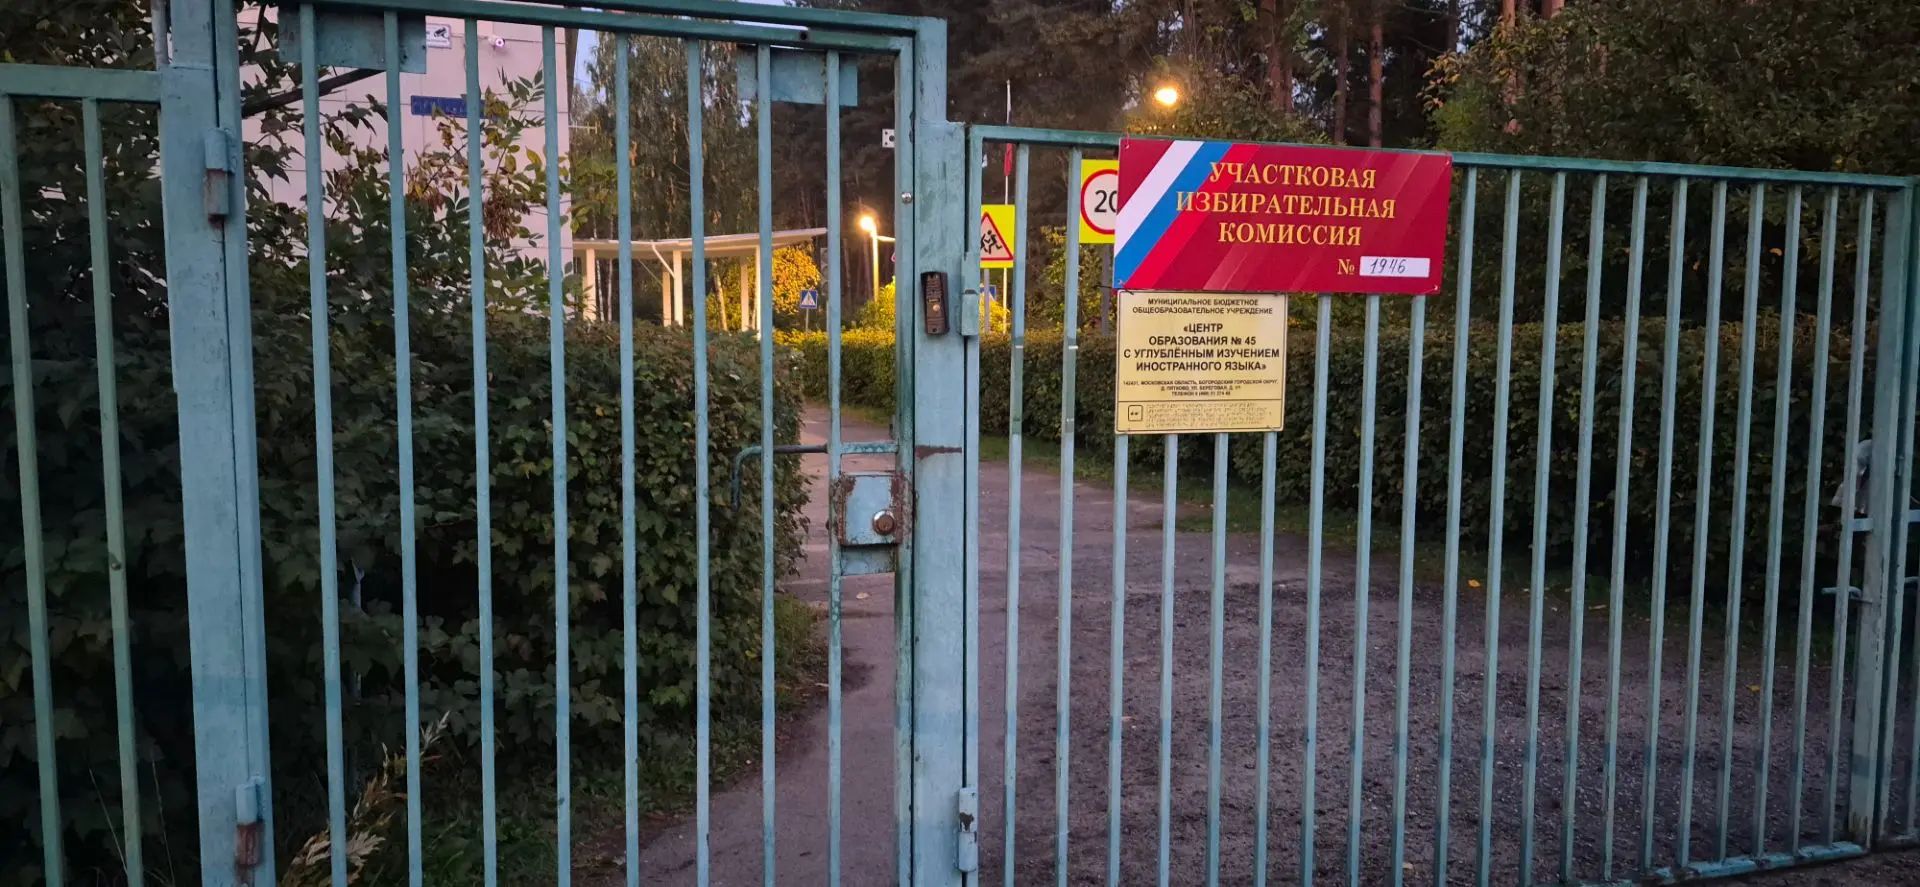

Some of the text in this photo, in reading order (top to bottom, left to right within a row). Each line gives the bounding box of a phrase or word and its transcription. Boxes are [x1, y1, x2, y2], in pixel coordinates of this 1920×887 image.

[1209, 161, 1376, 189] УЧАСТКОВАЯ
[1175, 190, 1396, 219] ИЗБИРАТЕЛЬНАЯ
[1218, 222, 1362, 246] КОМИССИЯ
[1337, 257, 1406, 275] № 1946
[1147, 298, 1258, 306] МУНИЦИПАЛЬНОЕ БЮДЖЕТНОЕ
[1226, 307, 1273, 315] УЧРЕЖДЕНИЕ
[1183, 323, 1223, 334] «ЦЕНТР
[1148, 336, 1256, 345] ОБРАЗОВАНИЯ № 45
[1123, 346, 1280, 358] С УГЛУБЛЁННЫМ ИЗУЧЕНИЕМ
[1136, 361, 1266, 371] ИНОСТРАННОГО ЯЗЫКА»
